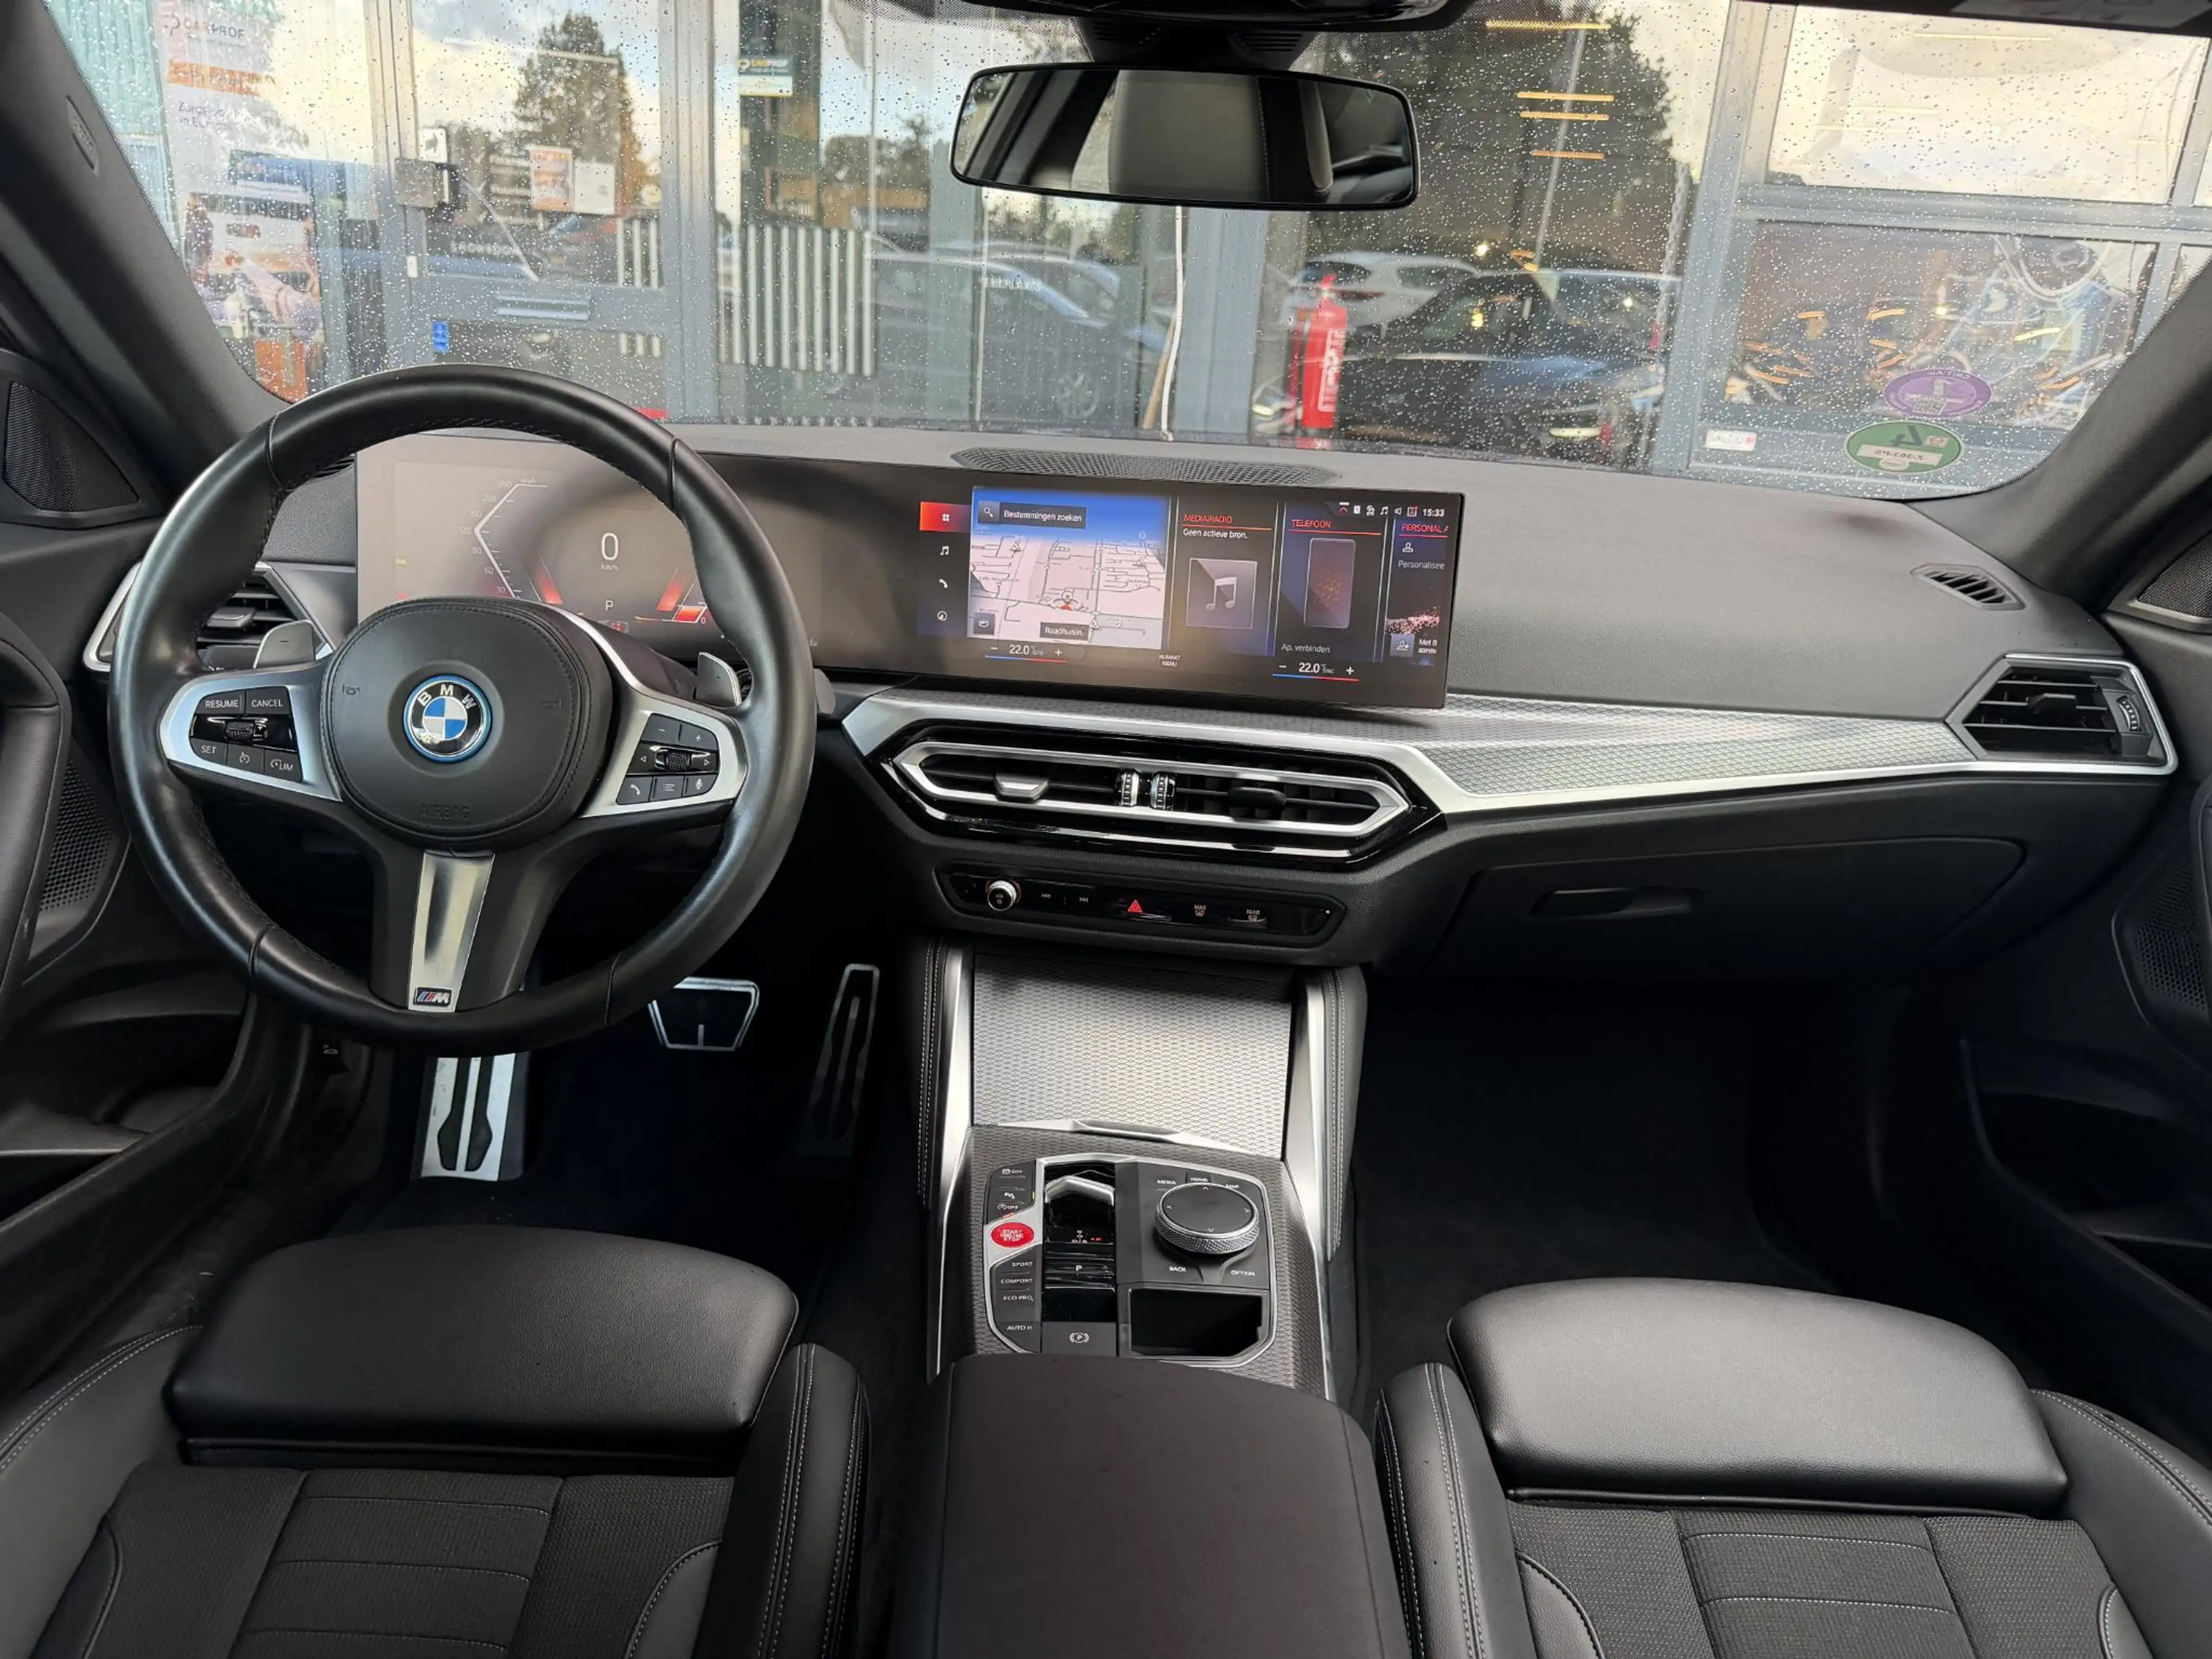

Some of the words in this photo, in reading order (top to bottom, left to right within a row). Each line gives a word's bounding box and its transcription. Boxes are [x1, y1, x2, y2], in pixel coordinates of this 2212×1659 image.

[1004, 509, 1056, 522] Bestemmingen
[1057, 514, 1082, 522] zoeken
[1422, 509, 1445, 517] 15:33
[1291, 518, 1332, 528] TELEFOON
[1401, 523, 1442, 533] PERSONAL
[1183, 528, 1202, 536] Geen
[1203, 530, 1228, 538] actieve
[1229, 532, 1248, 540] bron.
[601, 532, 619, 560] 0
[496, 586, 506, 594] 30
[605, 600, 614, 611] P
[1009, 644, 1030, 656] 22.0
[1294, 645, 1331, 654] verbinden
[1298, 662, 1320, 674] 22.0
[417, 684, 477, 710] BMW
[204, 699, 240, 708] RESUME
[251, 699, 283, 708] CANCEL
[200, 745, 217, 754] SET
[279, 761, 293, 772] LIM
[1230, 1269, 1256, 1277] OPTION
